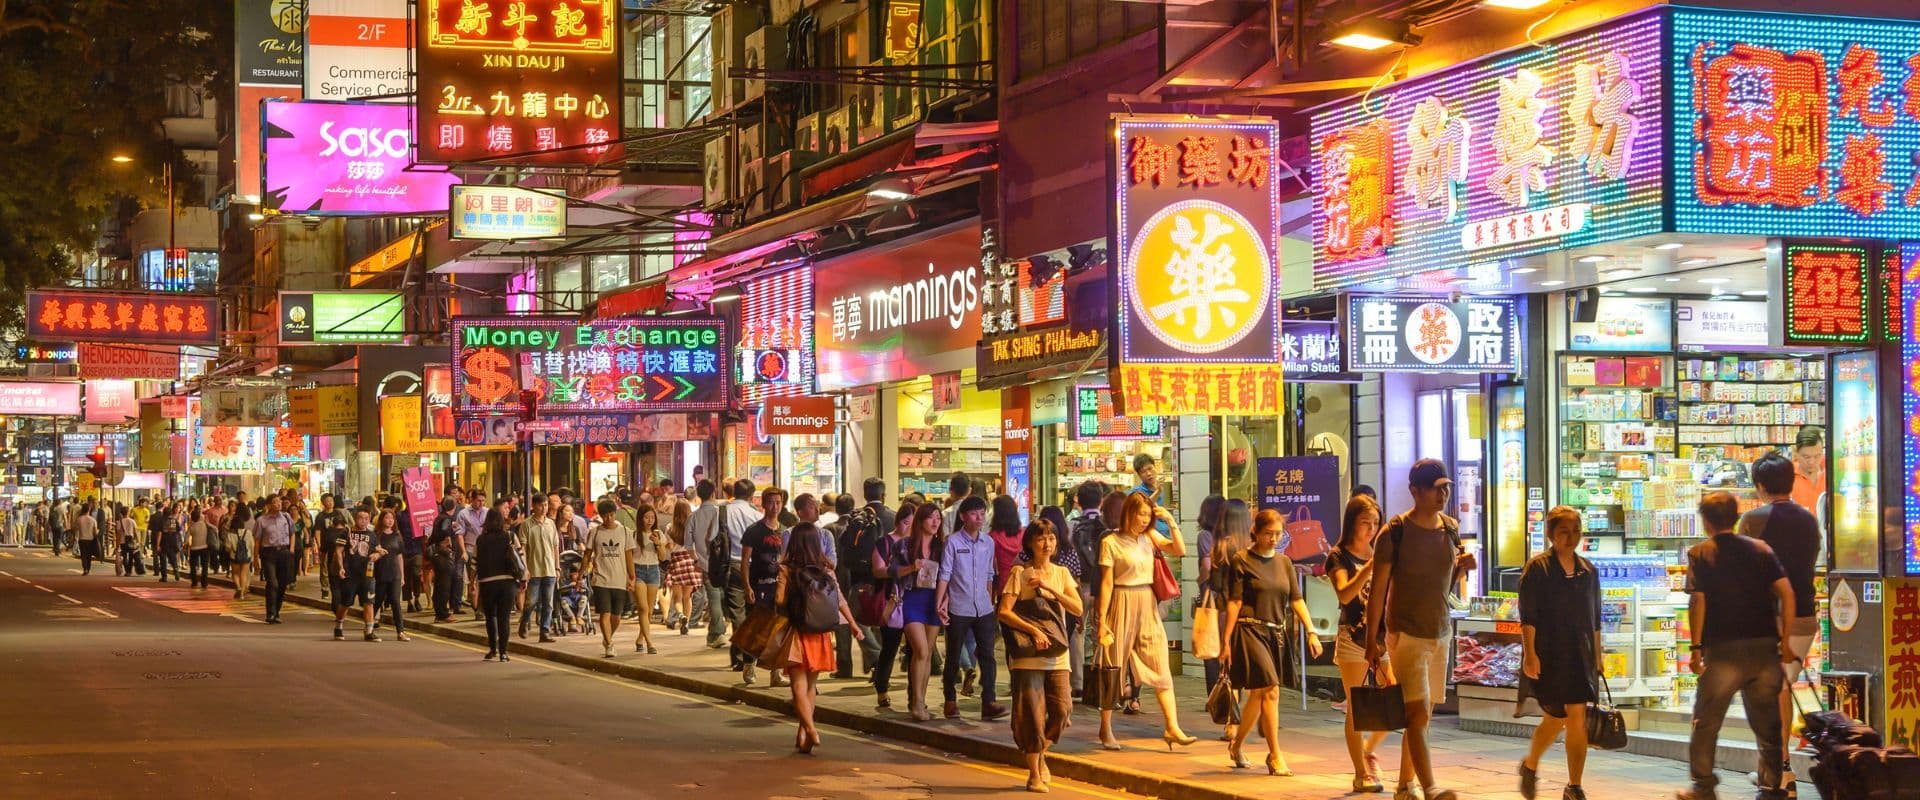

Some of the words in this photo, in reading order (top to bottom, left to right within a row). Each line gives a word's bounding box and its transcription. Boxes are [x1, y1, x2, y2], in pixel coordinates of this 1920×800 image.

[455, 0, 587, 38] 新斗記
[357, 24, 386, 41] 2/F
[259, 39, 285, 53] Thai
[252, 69, 299, 78] RESTAURANT
[483, 54, 512, 68] XIN
[516, 55, 550, 68] DAU
[552, 56, 565, 72] JI
[321, 83, 371, 96] Service
[490, 90, 610, 119] 九龍中心
[319, 121, 410, 158] Sasa
[438, 124, 610, 155] 即燒乳豬
[1404, 52, 1641, 221] 御藥坊
[347, 160, 384, 180] 莎莎
[1130, 135, 1270, 188] 御藥坊
[325, 186, 353, 198] making
[355, 185, 370, 197] life
[371, 186, 407, 197] beautiful
[465, 194, 533, 213] 阿里朗
[1150, 213, 1251, 339] 藥
[869, 262, 977, 332] mannings
[1793, 252, 1861, 333] 藥
[832, 293, 862, 342] 萬寧
[466, 327, 561, 350] Money
[576, 326, 717, 349] Exchange
[1362, 301, 1398, 364] 註冊
[1414, 306, 1453, 359] 藥
[1467, 303, 1503, 364] 政府
[82, 348, 149, 365] HENDERSON
[992, 338, 1009, 362] TAK
[1012, 333, 1041, 359] SHING
[80, 367, 116, 377] ROSEWOOD
[117, 367, 151, 377] FURNITURE
[156, 367, 176, 377] CHEST
[617, 350, 716, 375] 特快匯款
[1282, 361, 1308, 372] Milan
[1311, 362, 1340, 373] Statio
[1126, 367, 1279, 414] 蟲草燕窩直銷商
[457, 419, 485, 444] 4D
[580, 415, 618, 426] Service
[773, 415, 829, 428] mannings
[63, 433, 96, 441] BESPOKE
[399, 440, 438, 448] Welcome
[547, 427, 586, 443] 3599
[588, 426, 627, 442] 8899
[1275, 469, 1304, 483] 名牌
[1265, 485, 1303, 495] 高價回收
